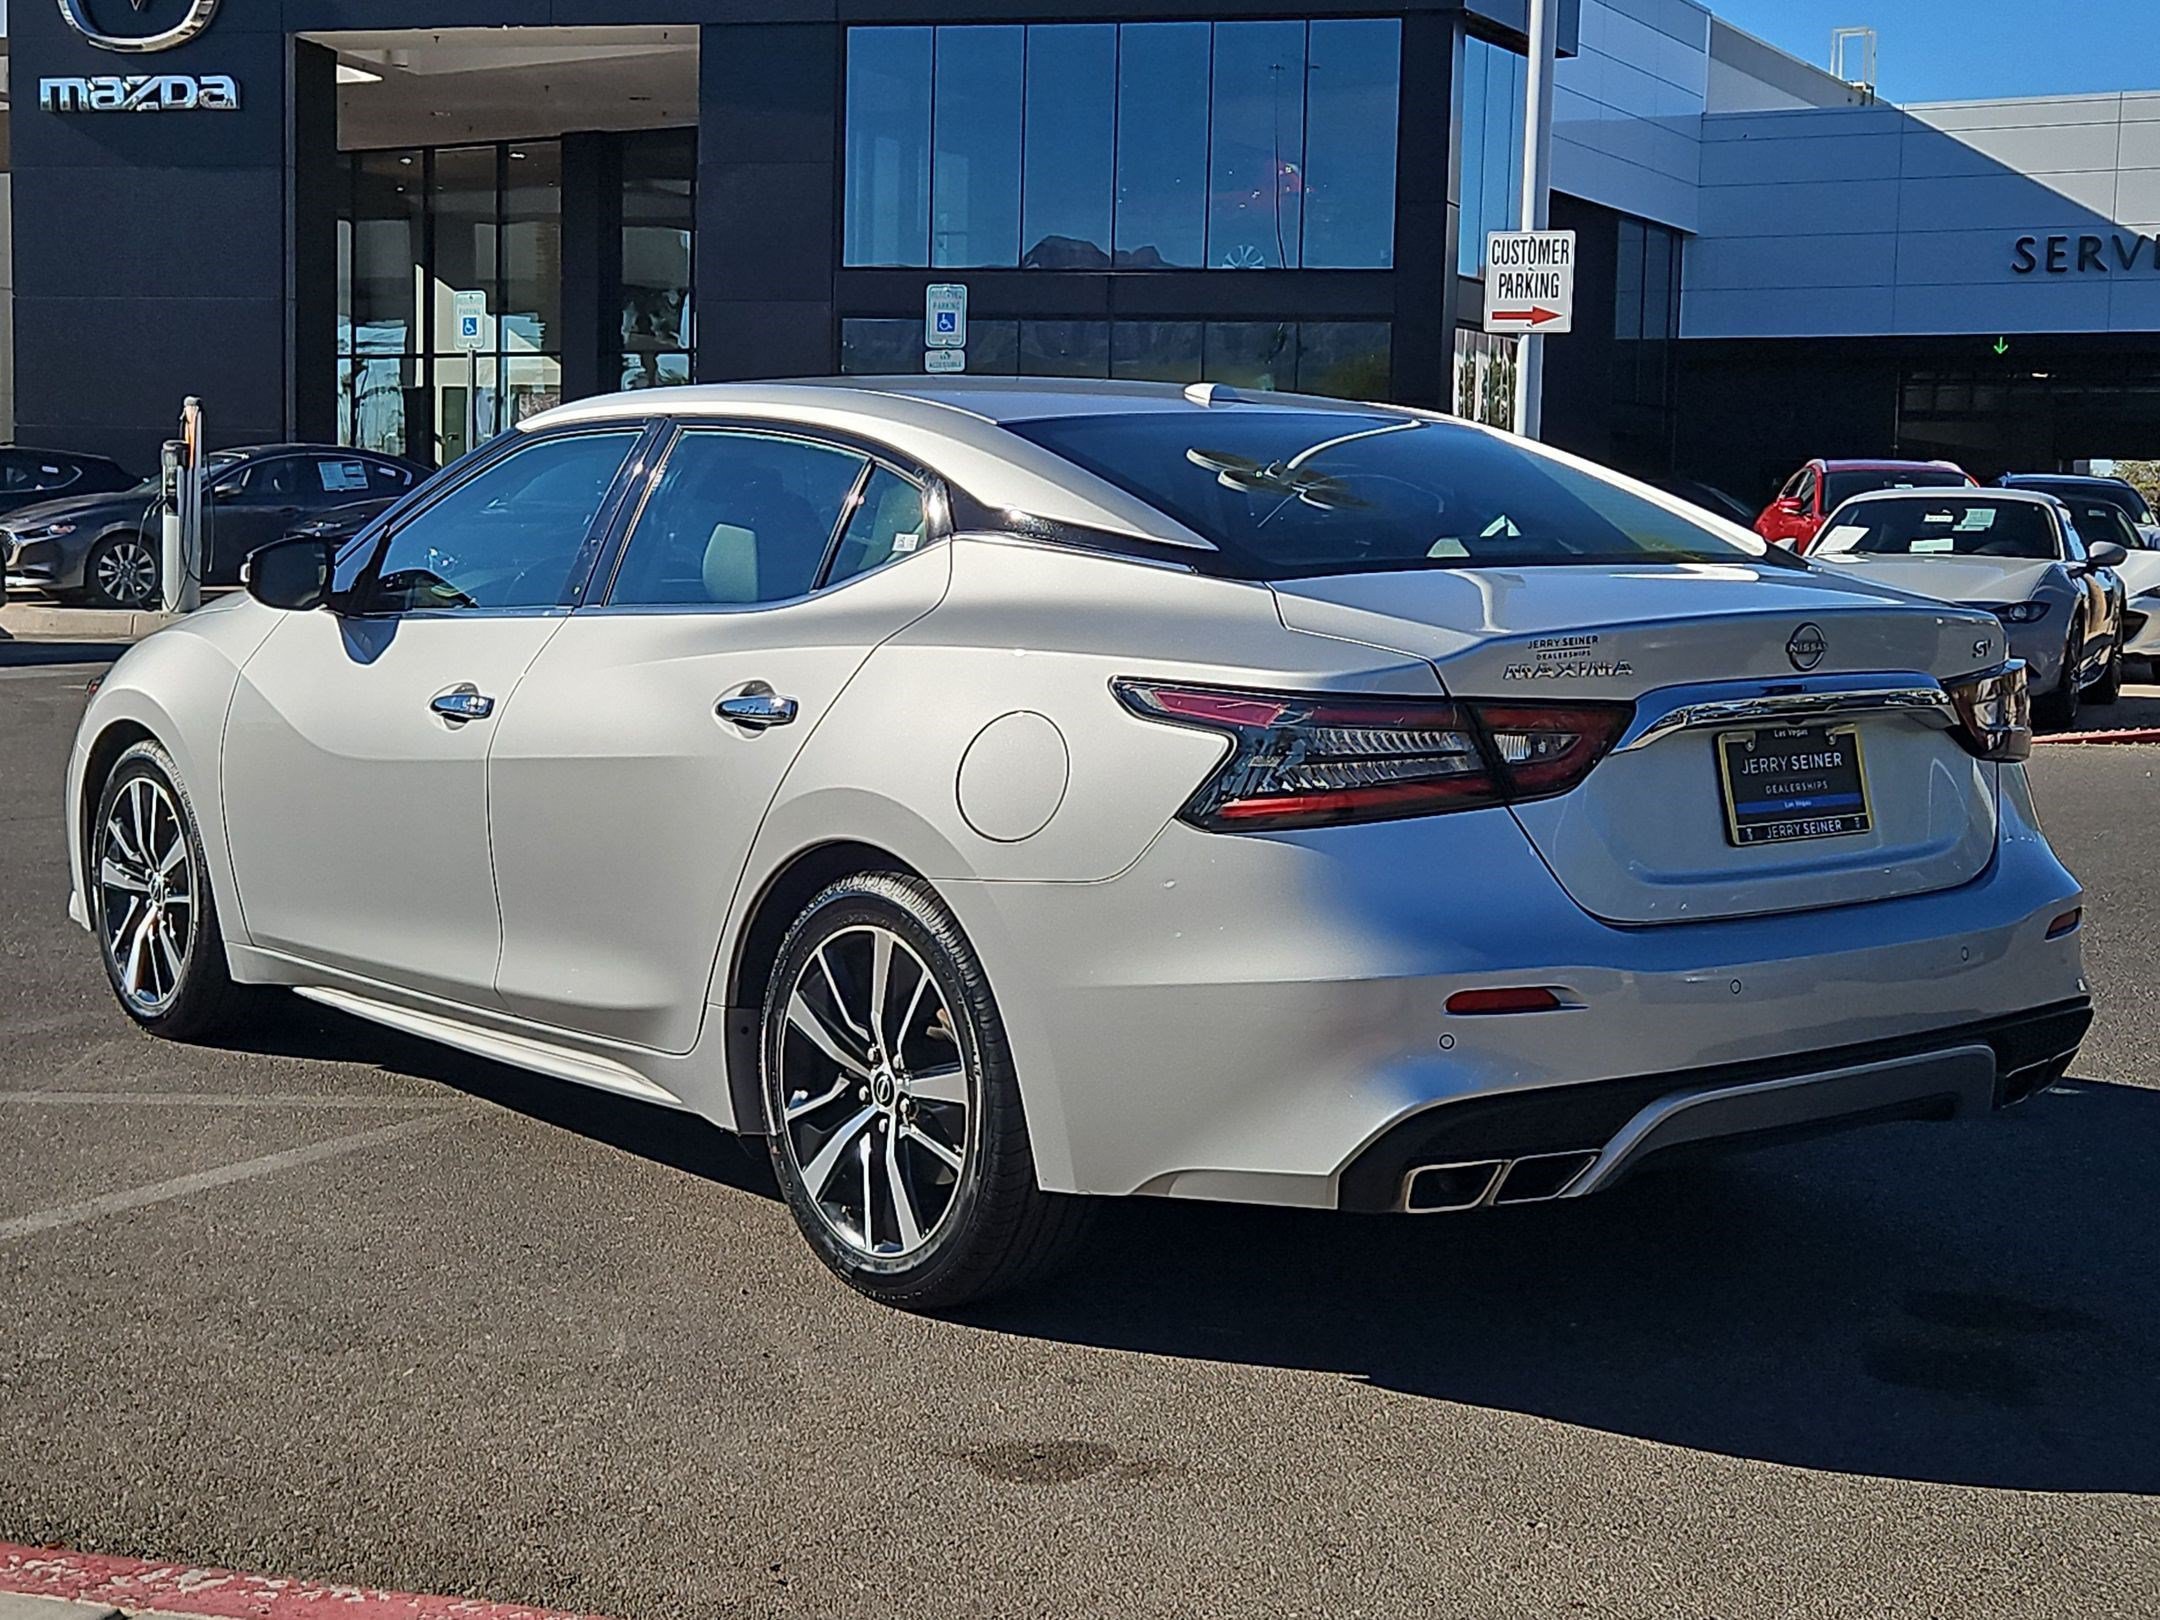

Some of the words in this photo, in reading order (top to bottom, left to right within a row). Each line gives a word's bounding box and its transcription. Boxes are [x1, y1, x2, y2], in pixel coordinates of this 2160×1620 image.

[1492, 238, 1569, 265] CUSTOMER
[1498, 272, 1560, 299] PARKING
[1527, 638, 1561, 650] JERRY
[1562, 635, 1599, 647] SEINER
[1536, 650, 1591, 660] DEALERSHIPS
[1503, 660, 1634, 679] MAXIMA
[1741, 755, 1788, 775] JERRY
[1791, 752, 1843, 770] SEINER
[1765, 780, 1828, 794] DEALERSHIPS
[1767, 824, 1800, 839] JERRY
[1803, 819, 1842, 835] SEINER
